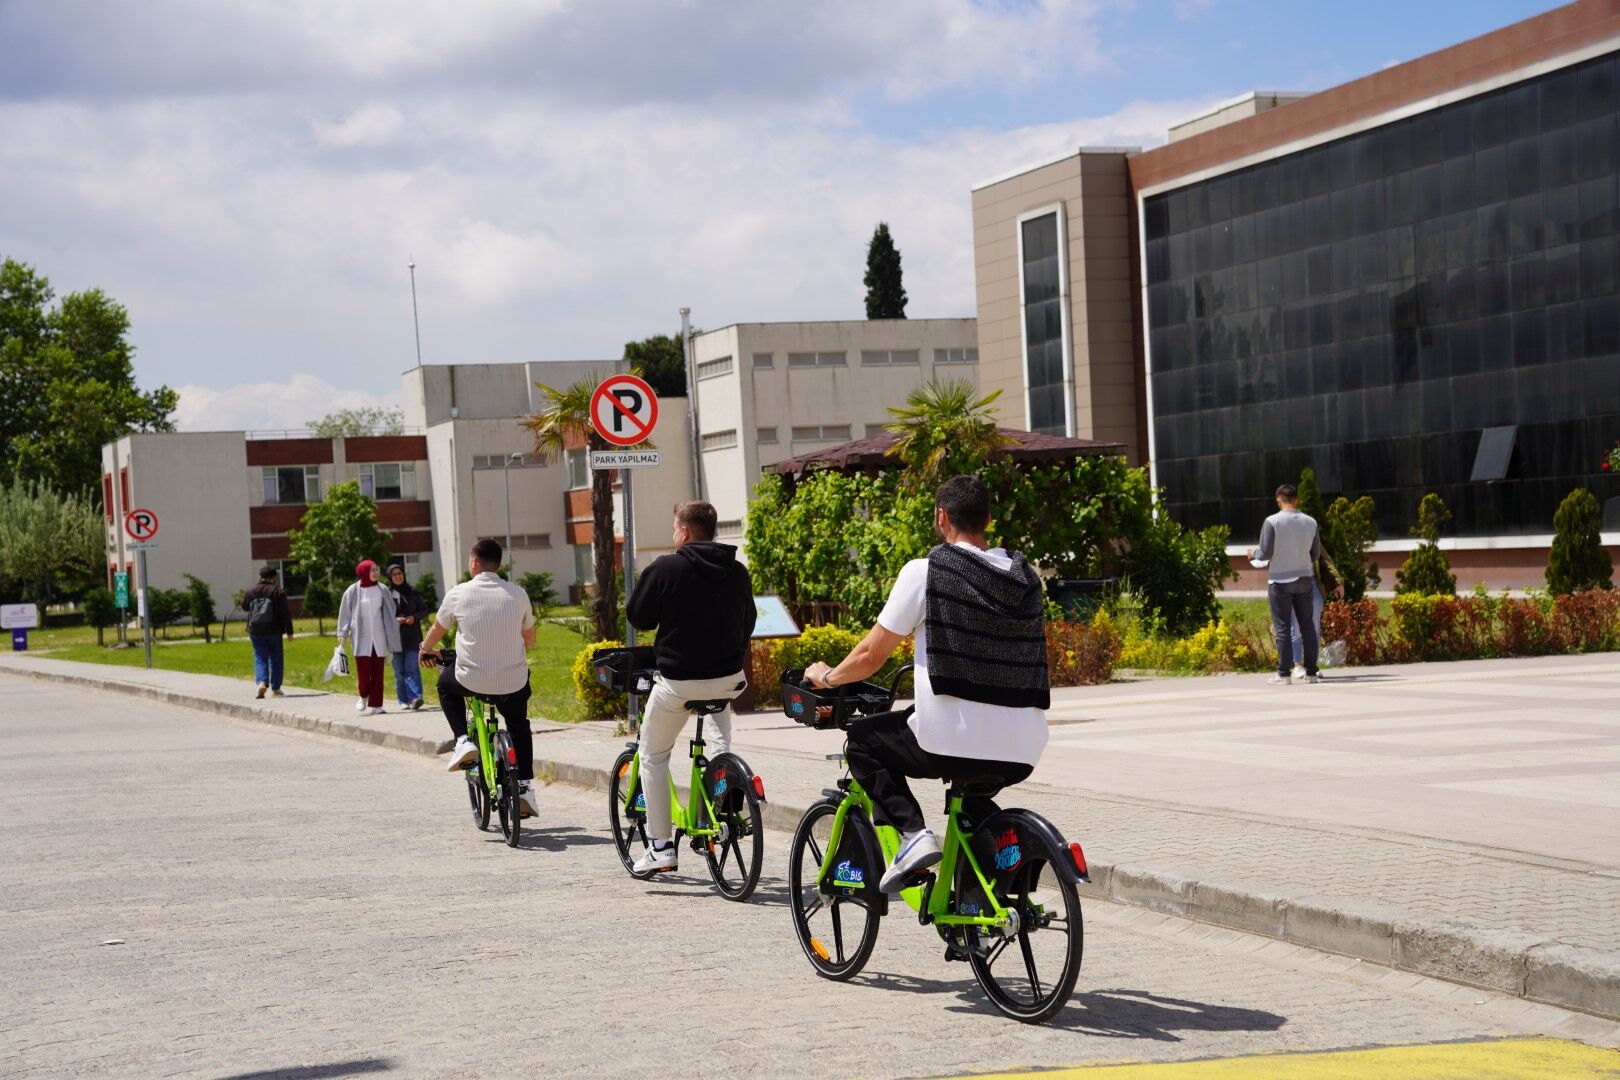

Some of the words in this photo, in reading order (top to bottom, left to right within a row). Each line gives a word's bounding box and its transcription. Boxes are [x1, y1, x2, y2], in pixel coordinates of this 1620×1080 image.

[612, 389, 642, 432] P
[595, 456, 617, 464] PARK
[618, 454, 657, 463] YAPILMAZ
[135, 514, 150, 534] P
